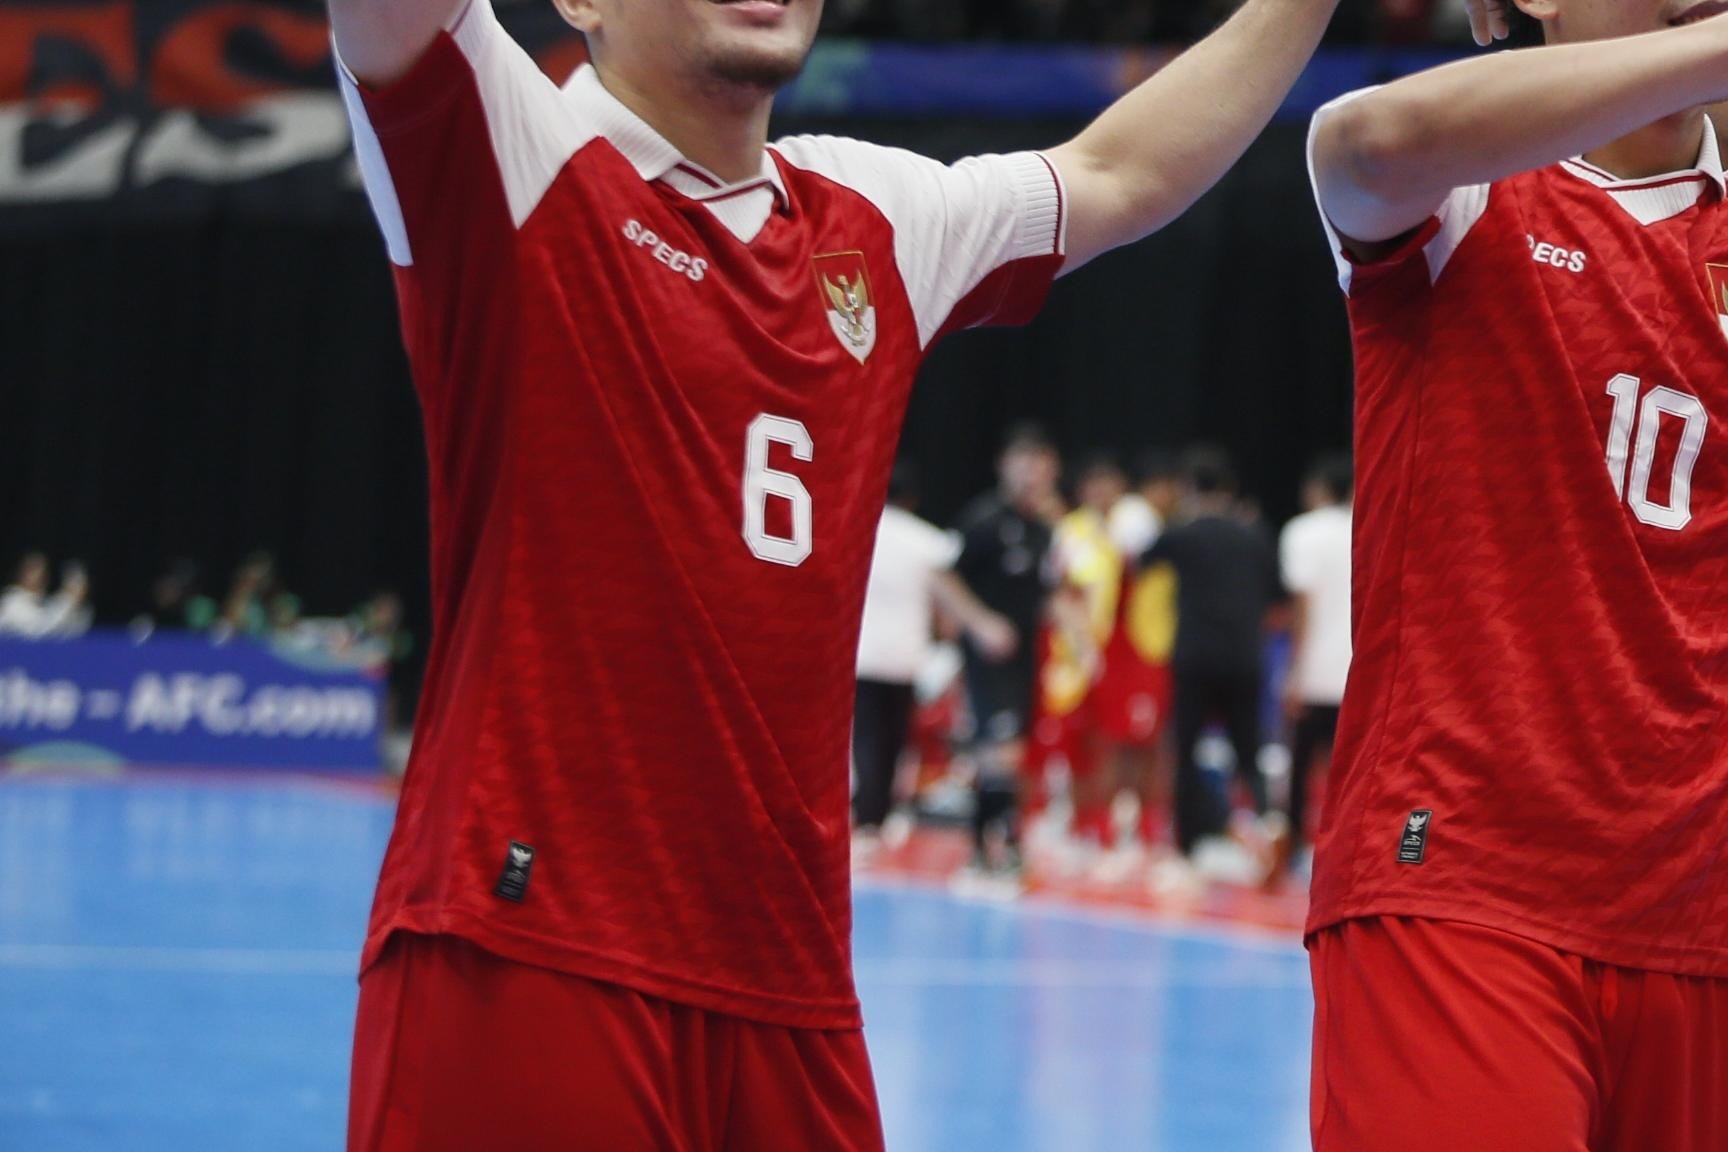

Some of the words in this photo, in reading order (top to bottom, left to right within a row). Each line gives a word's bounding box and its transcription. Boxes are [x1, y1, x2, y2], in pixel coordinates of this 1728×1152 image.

[622, 219, 708, 282] SPECS
[742, 412, 814, 568] 6
[1604, 372, 1709, 531] 10
[127, 673, 376, 740] AFC.com
